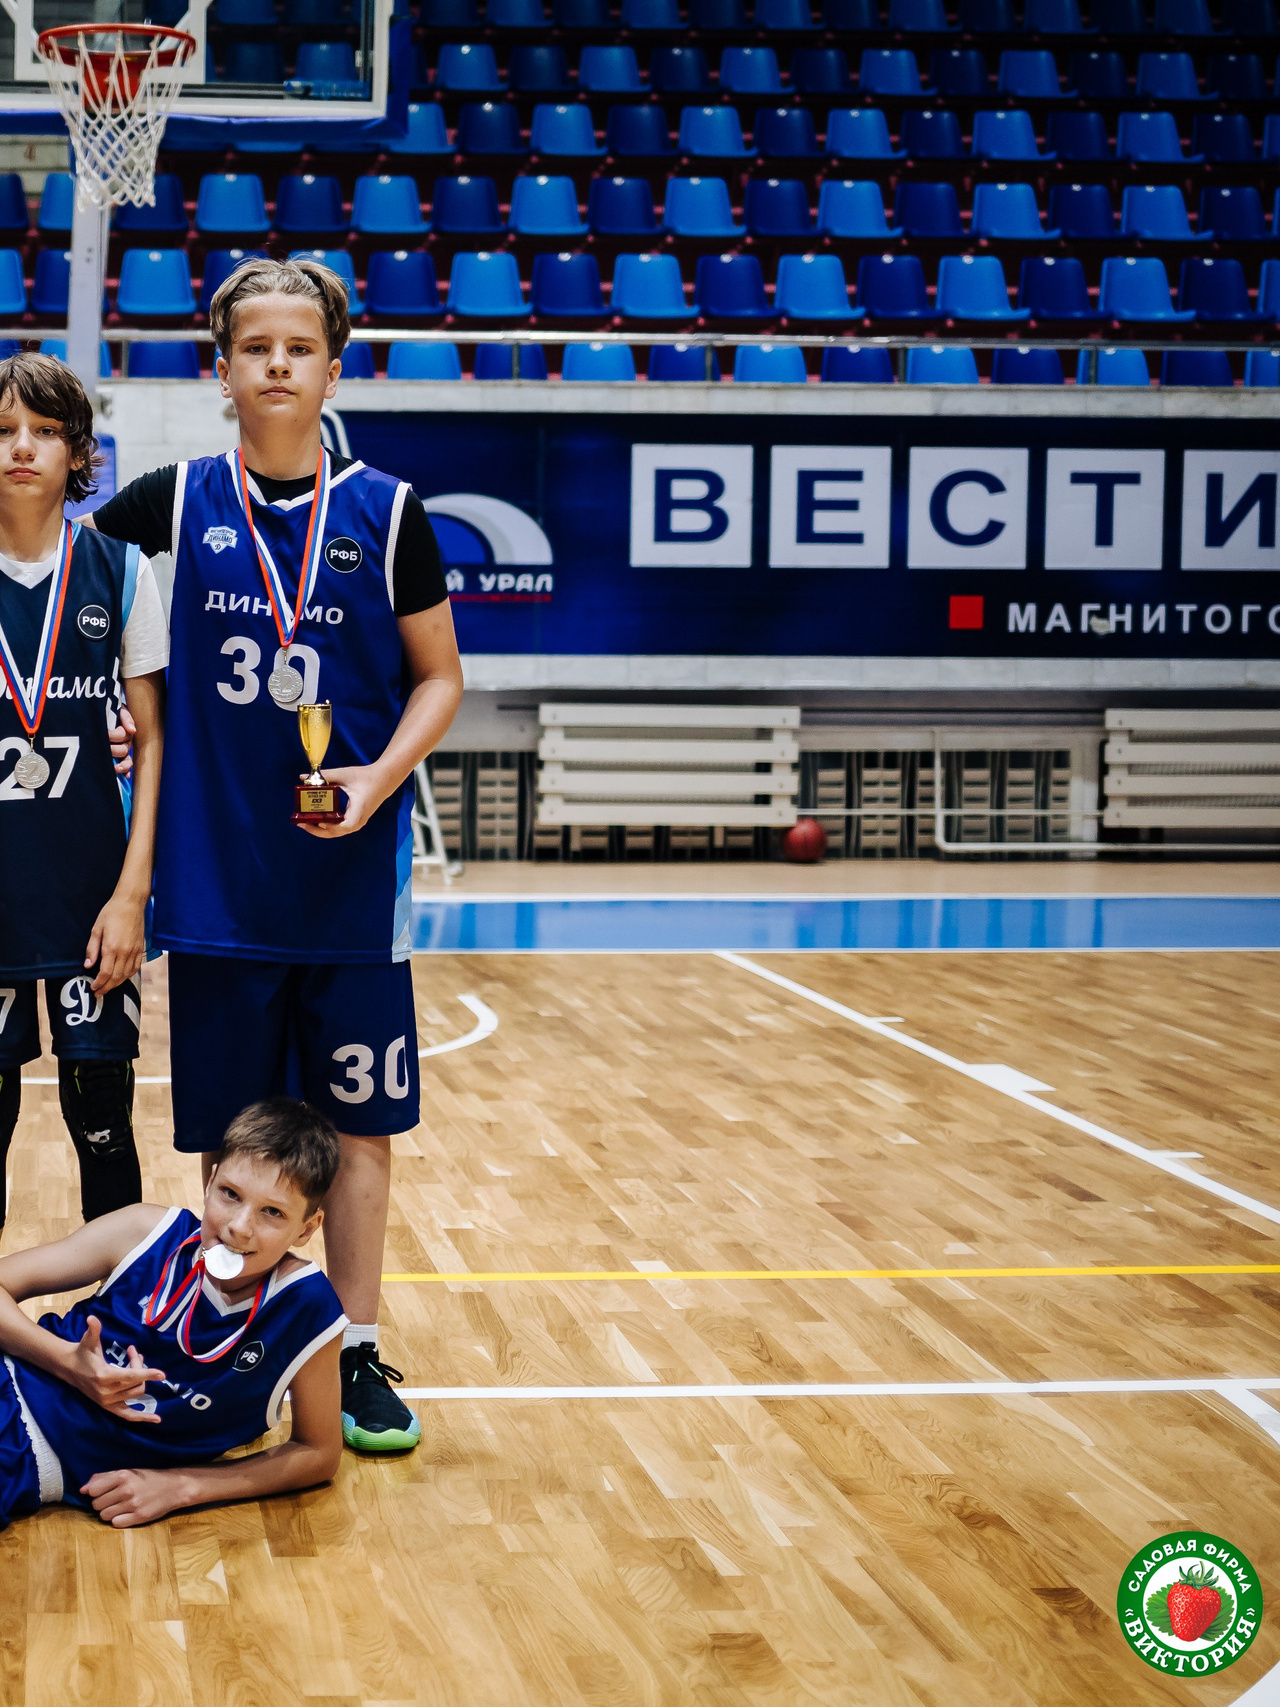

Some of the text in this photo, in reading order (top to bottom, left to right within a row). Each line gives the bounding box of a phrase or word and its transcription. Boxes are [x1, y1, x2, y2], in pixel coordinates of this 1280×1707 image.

[653, 468, 1278, 549] ВЕСТИ
[330, 549, 358, 561] РФБ
[478, 573, 553, 592] УРАЛ
[204, 590, 345, 625] ДИНМО
[82, 615, 107, 628] РФБ
[216, 635, 321, 712] 30
[329, 1035, 409, 1104] 30
[240, 1351, 259, 1364] РБ
